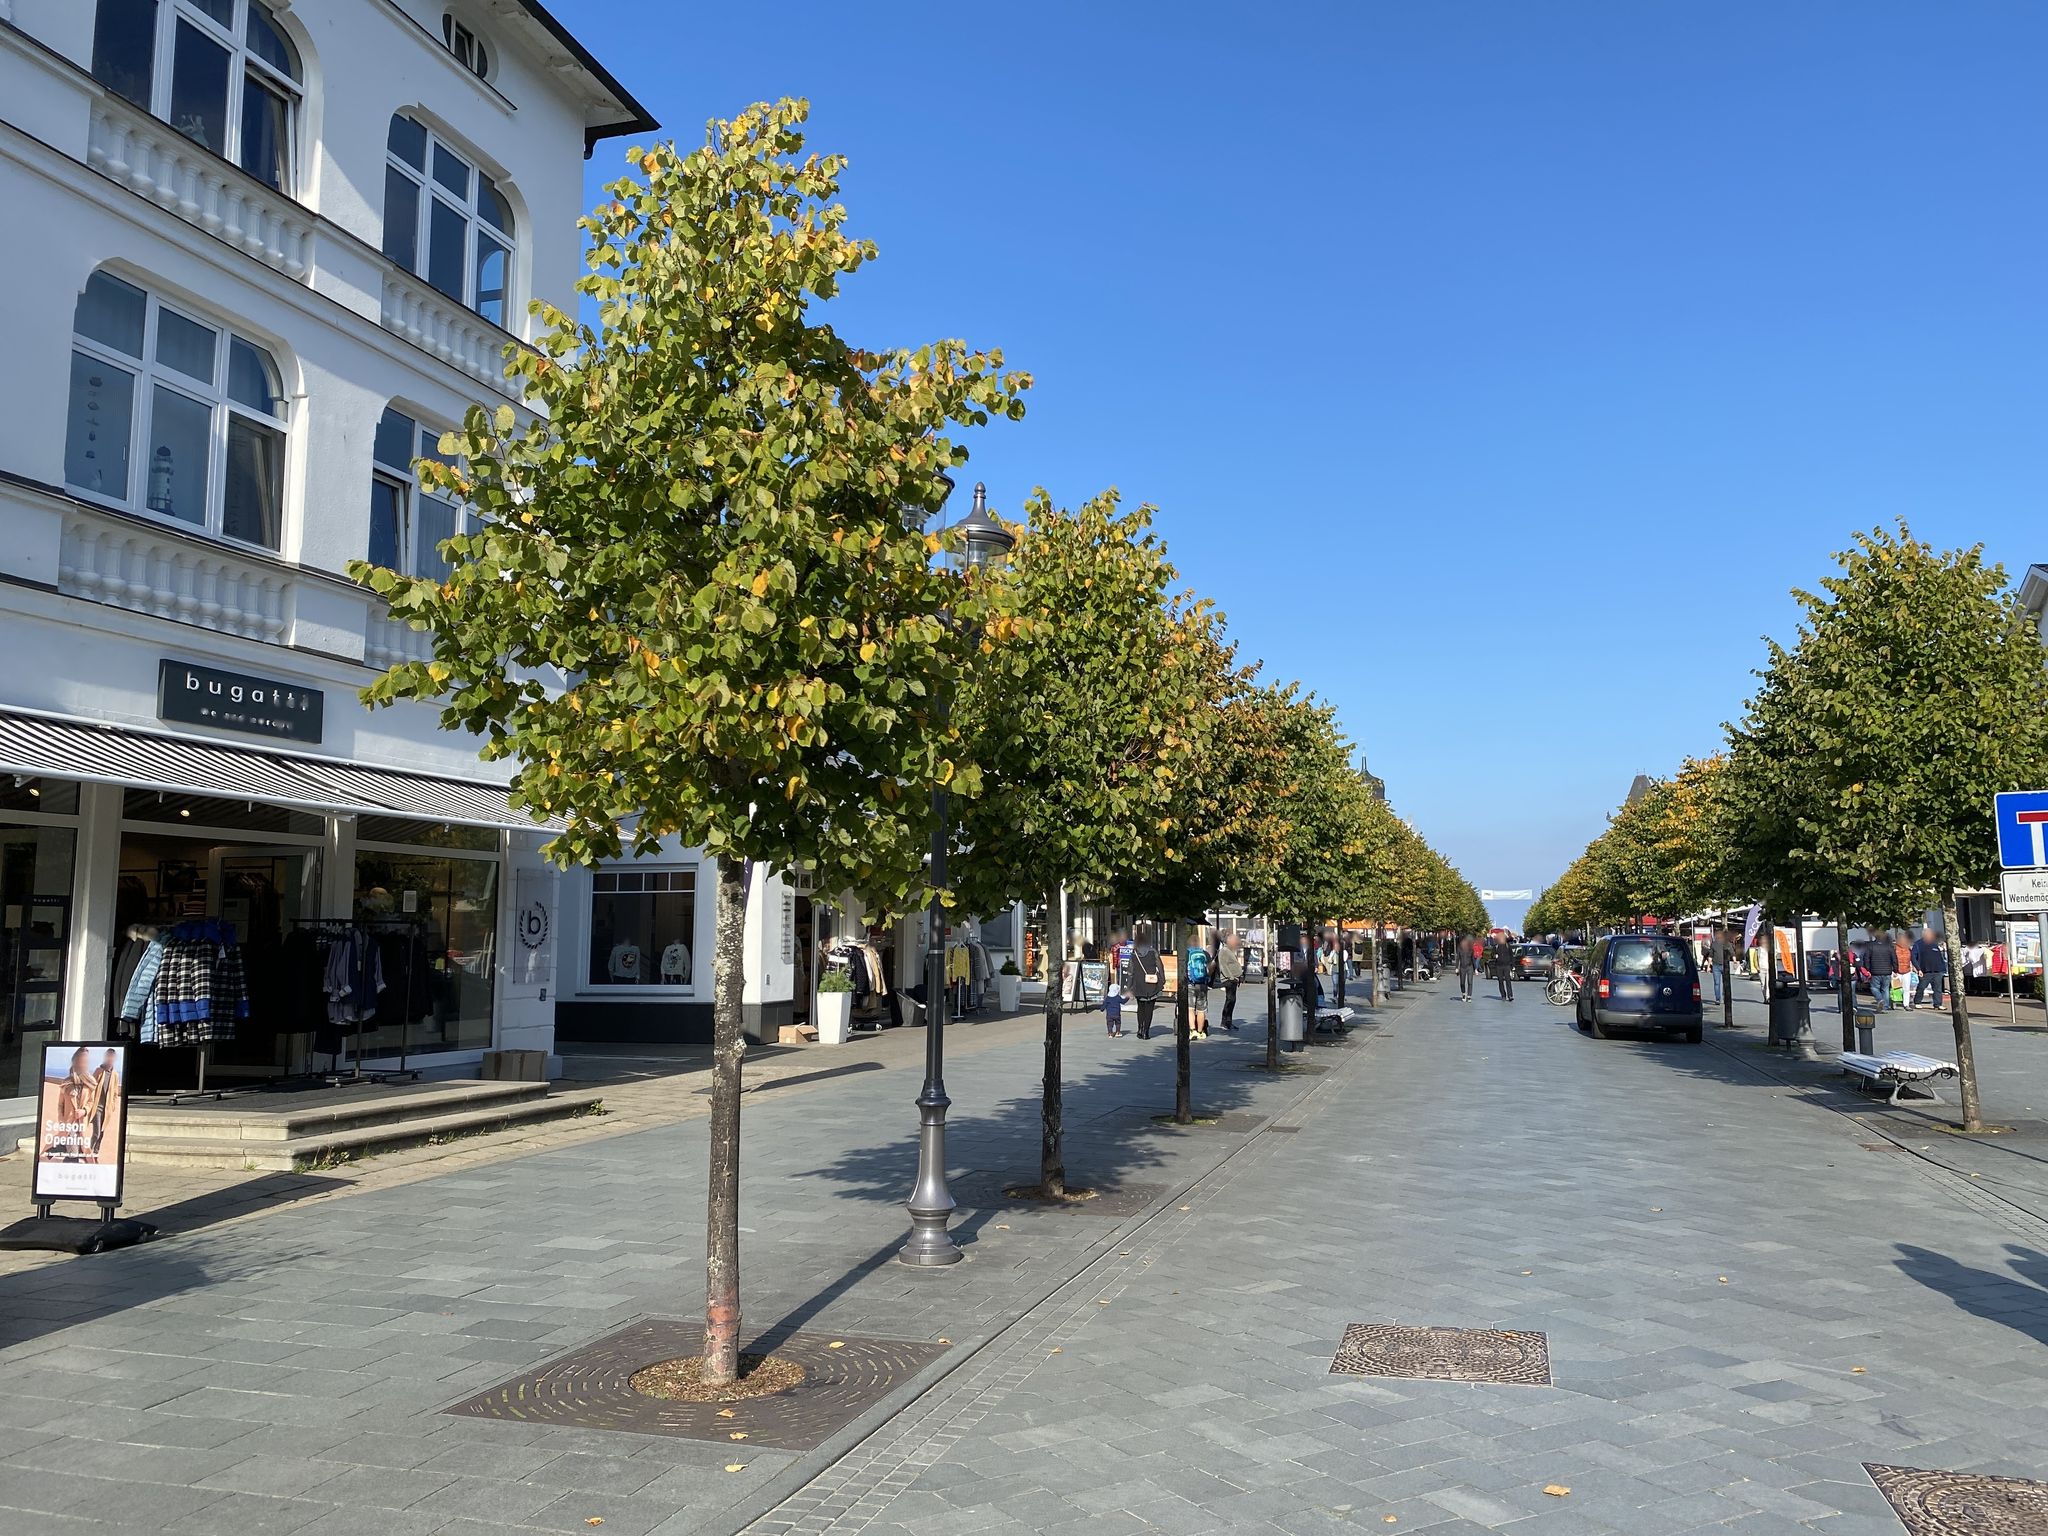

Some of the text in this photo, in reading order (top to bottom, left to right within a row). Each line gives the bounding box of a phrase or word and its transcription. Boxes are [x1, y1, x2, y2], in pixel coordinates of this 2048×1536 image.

[186, 671, 309, 711] bugatti
[528, 910, 541, 935] b
[1748, 913, 1764, 937] ecc
[45, 1120, 86, 1132] Season
[45, 1133, 91, 1148] Opening
